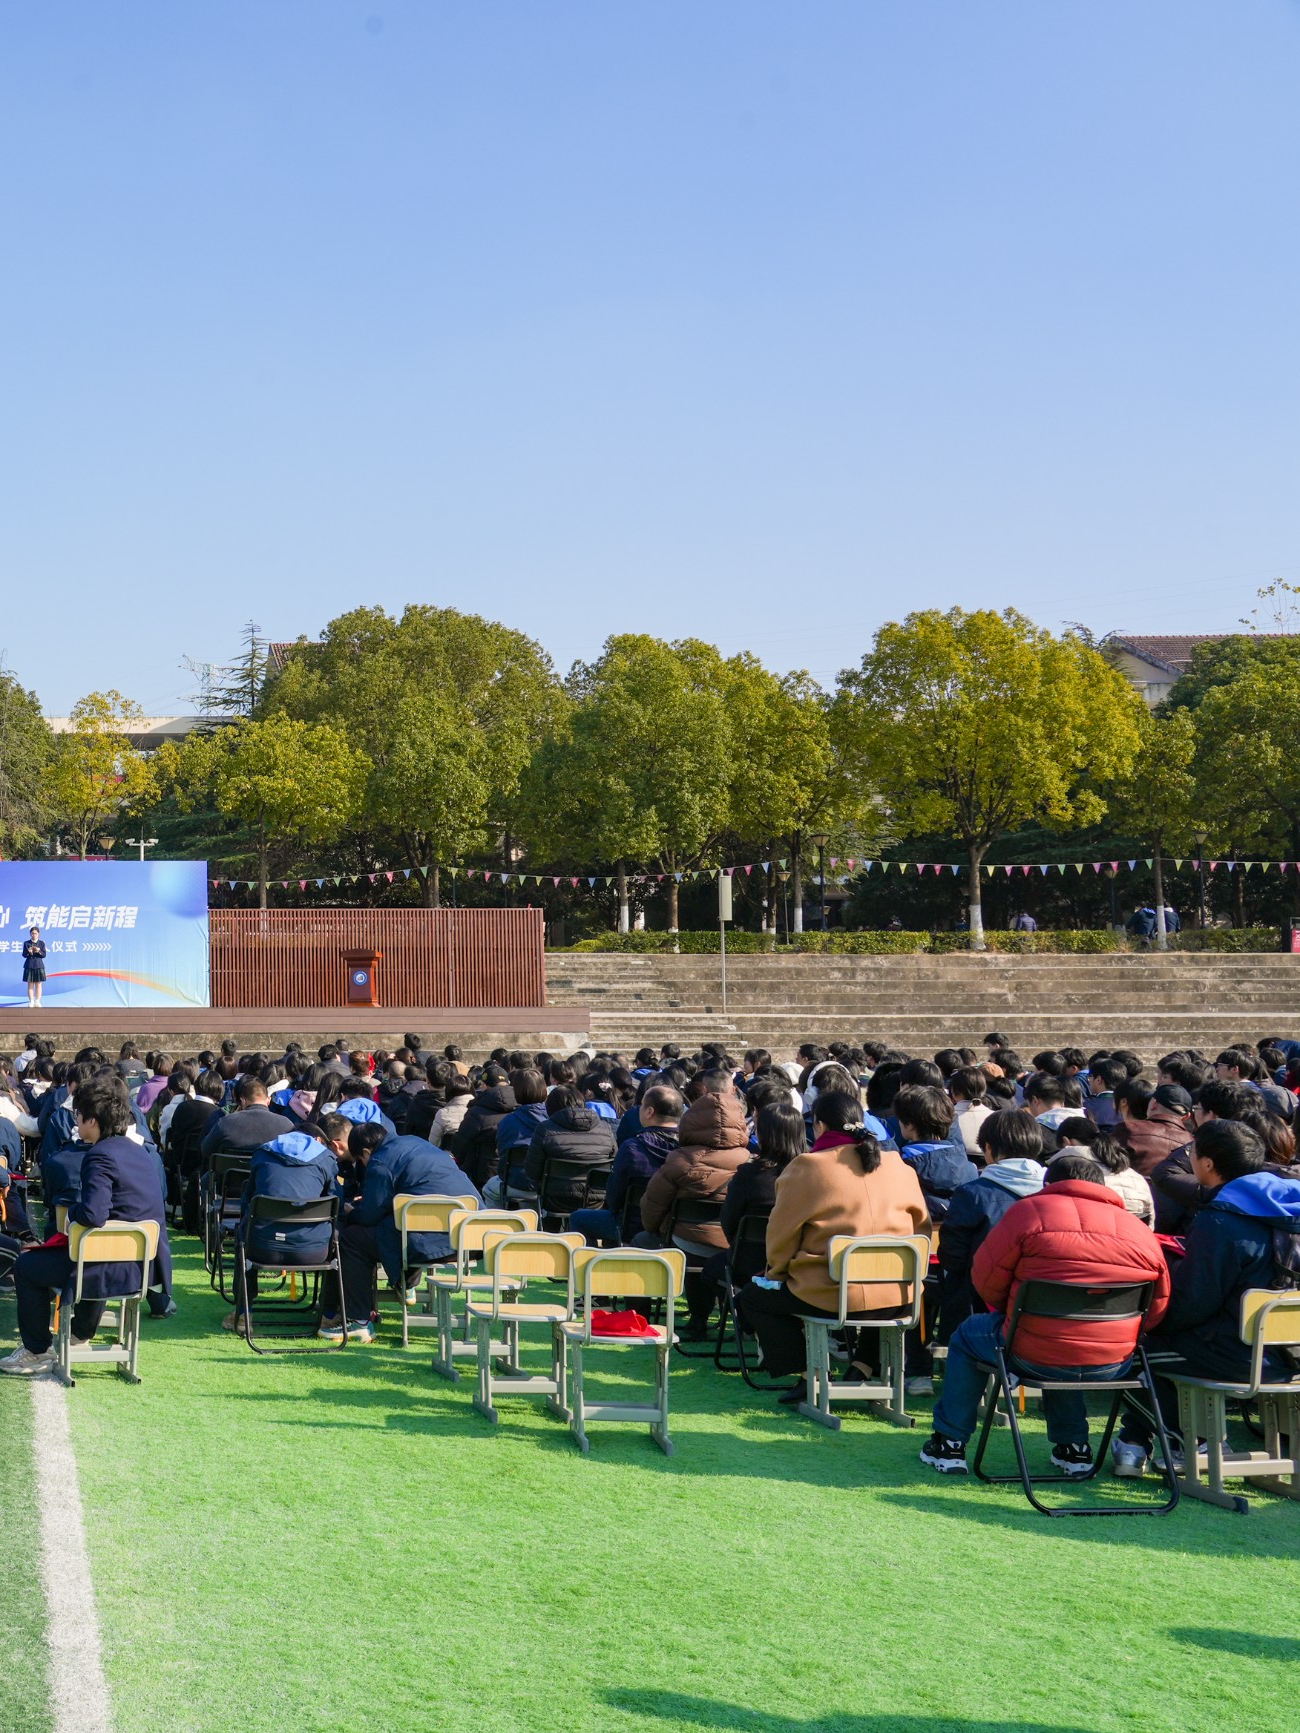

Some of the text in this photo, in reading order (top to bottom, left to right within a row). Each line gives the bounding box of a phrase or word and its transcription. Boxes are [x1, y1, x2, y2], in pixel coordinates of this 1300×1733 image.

[20, 904, 139, 931] 筑能启新程
